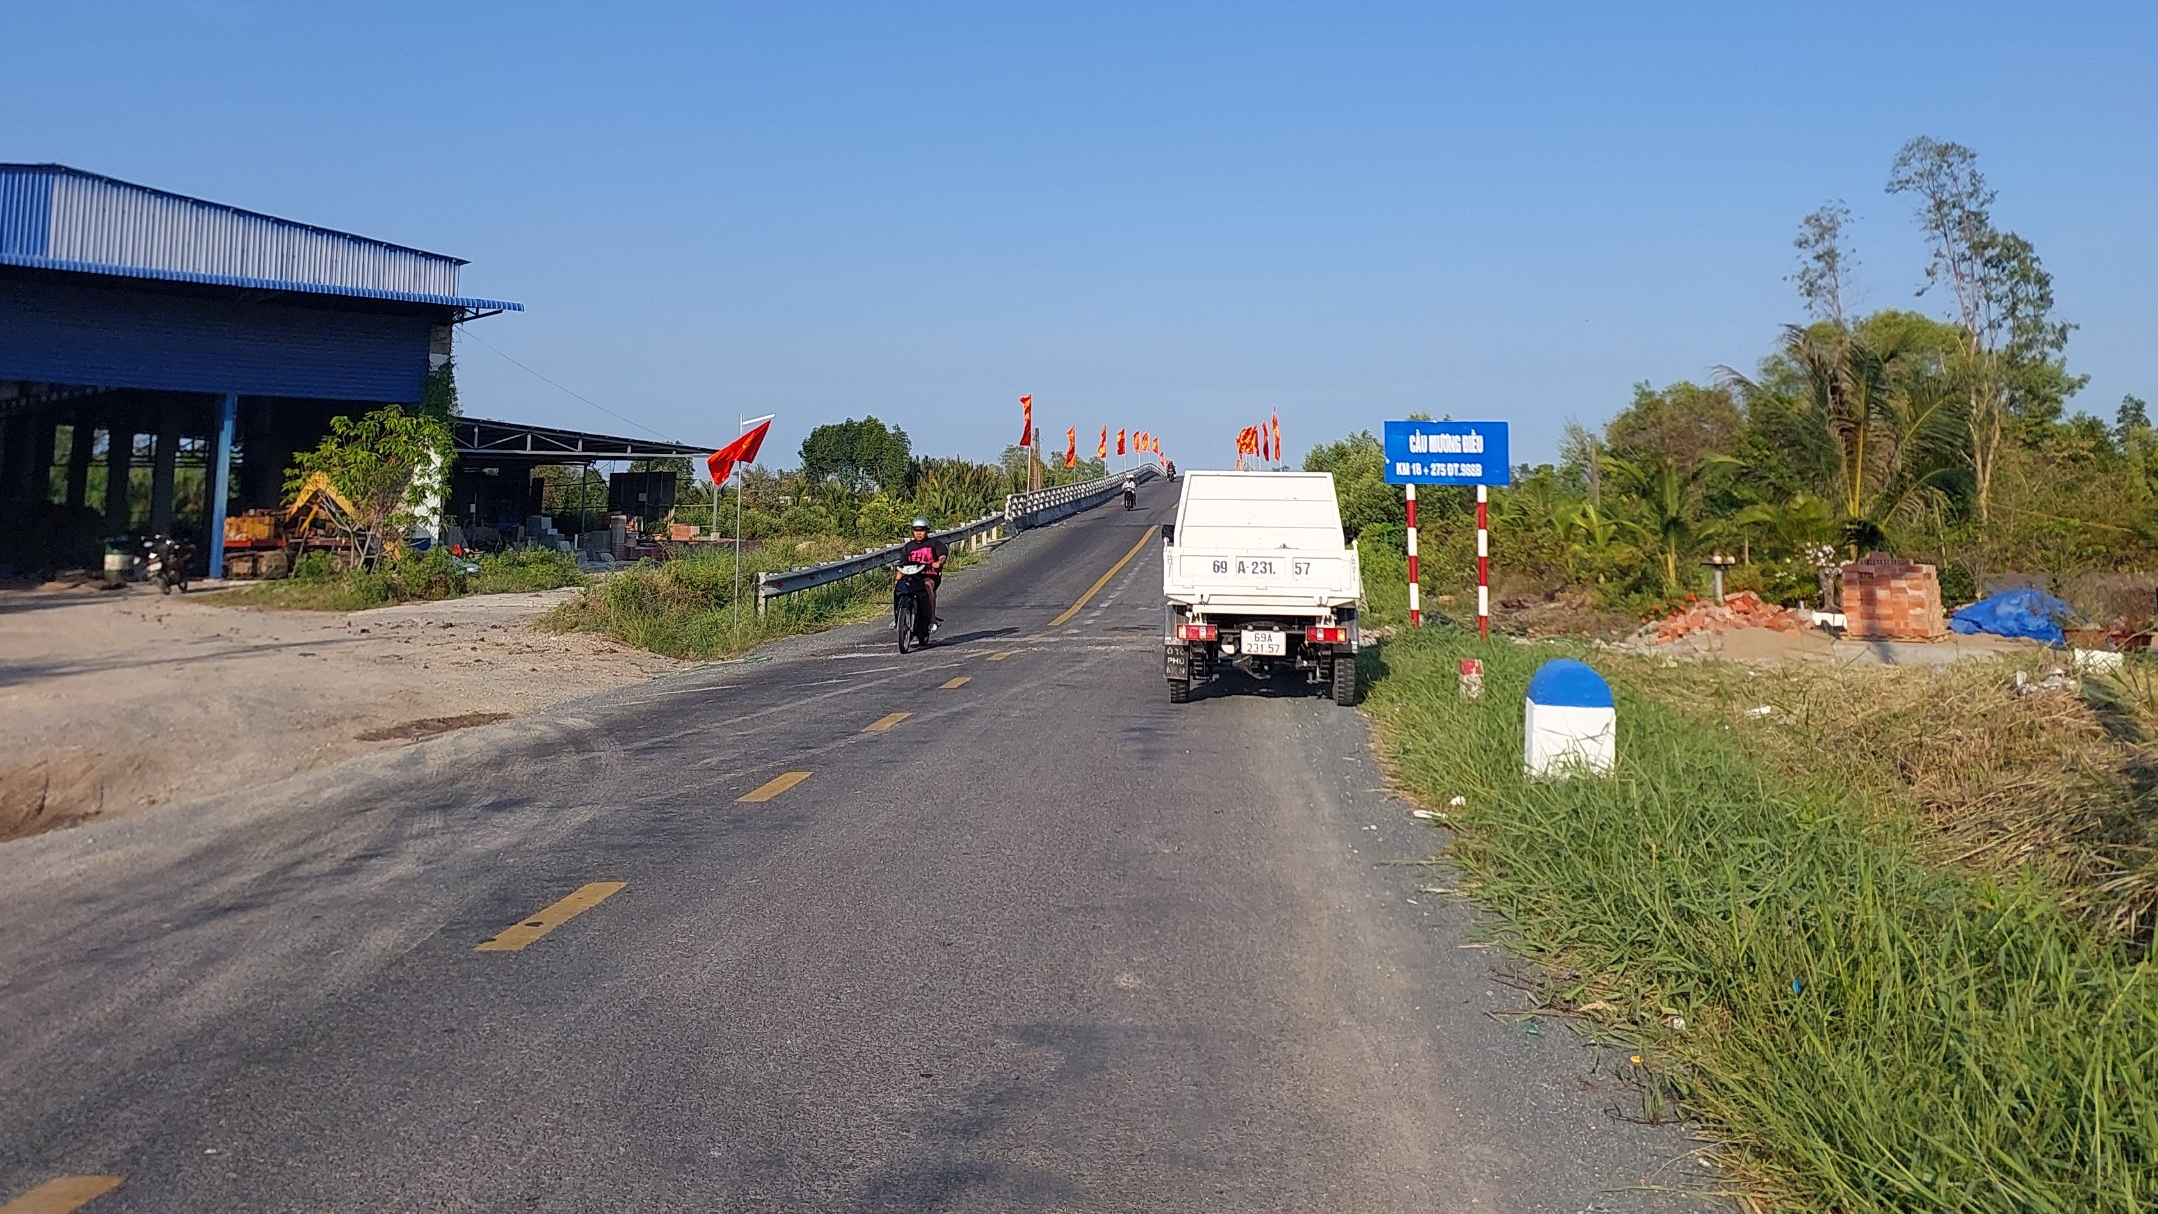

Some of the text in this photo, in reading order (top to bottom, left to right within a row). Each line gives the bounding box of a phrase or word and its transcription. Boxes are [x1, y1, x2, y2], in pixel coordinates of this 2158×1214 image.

[1409, 429, 1428, 454] CẦU
[1396, 462, 1410, 476] KM
[1411, 462, 1422, 476] 18
[1430, 463, 1446, 477] 275
[1212, 560, 1228, 574] 69
[1294, 562, 1311, 576] 57
[1254, 632, 1273, 643] 69A
[1247, 643, 1280, 653] 231.57
